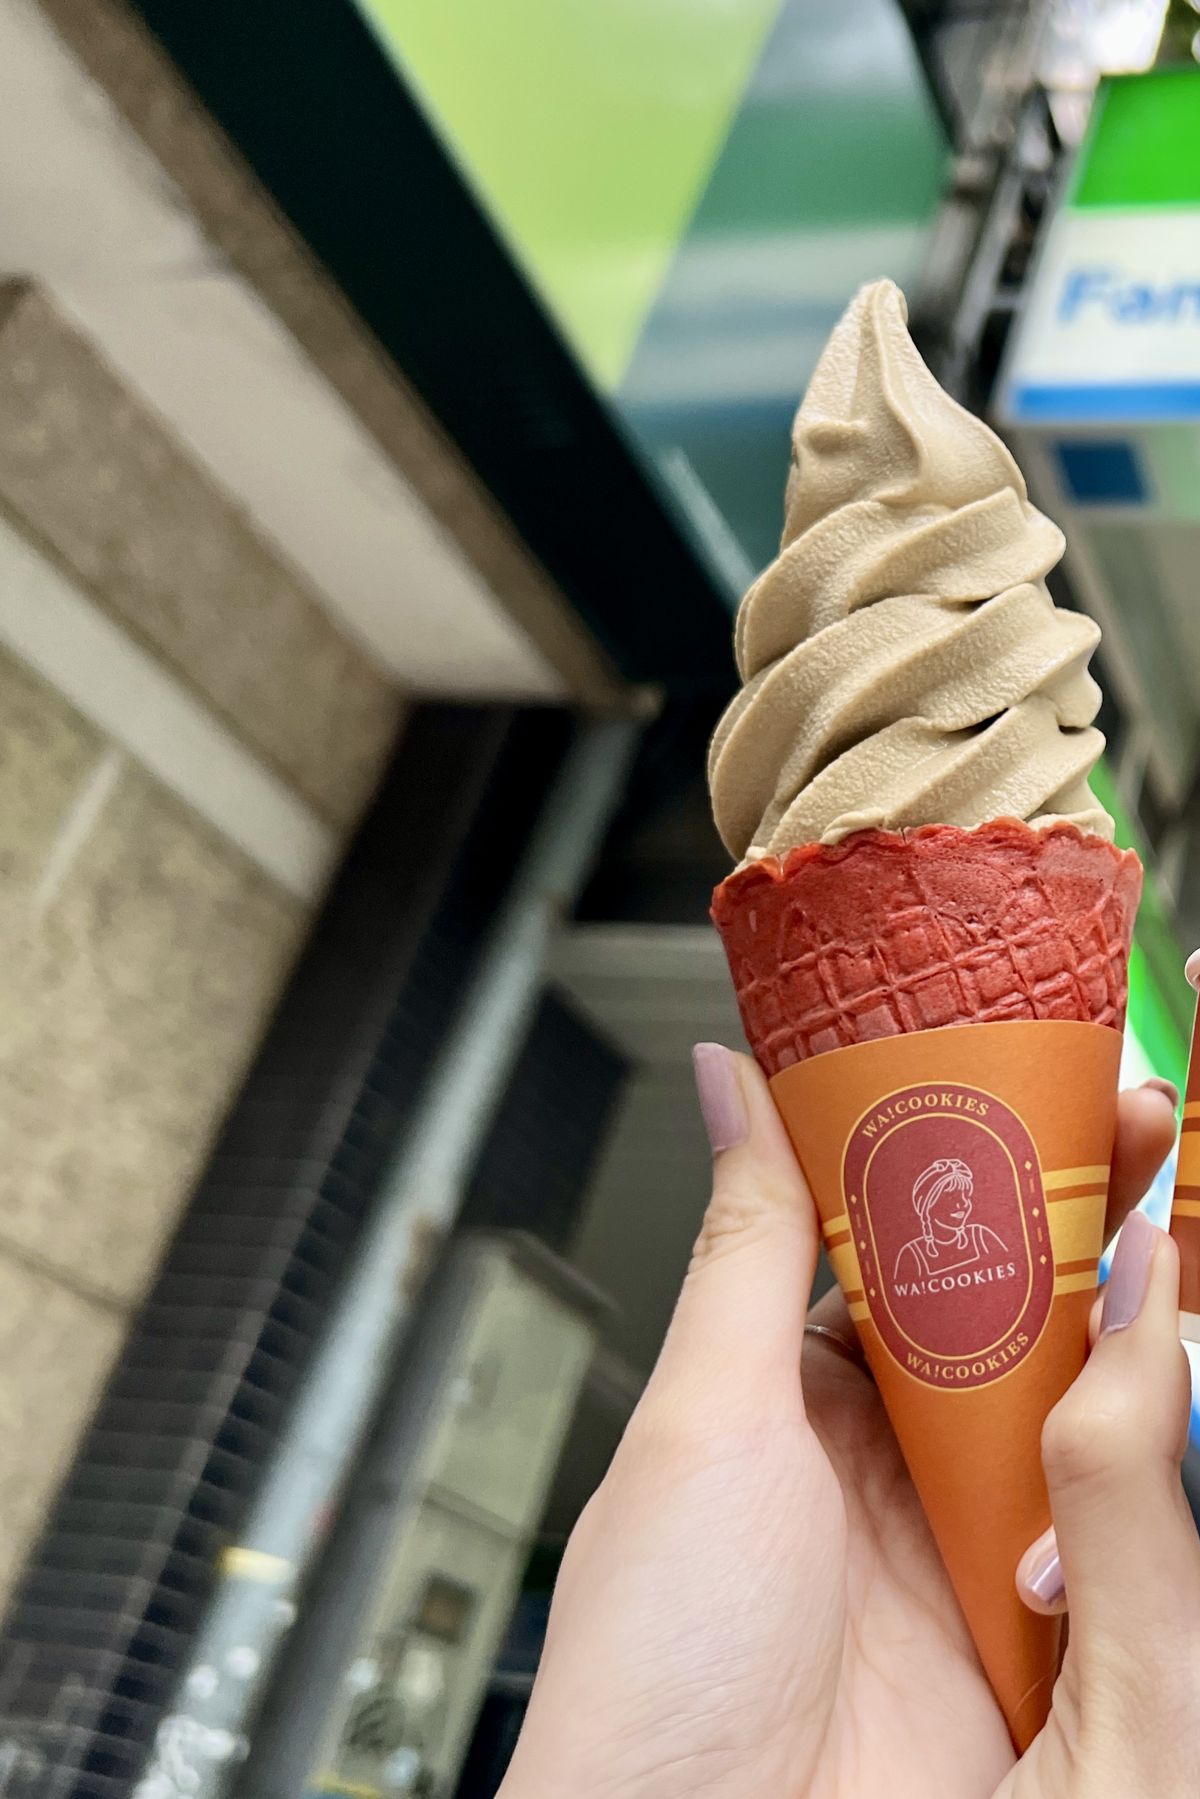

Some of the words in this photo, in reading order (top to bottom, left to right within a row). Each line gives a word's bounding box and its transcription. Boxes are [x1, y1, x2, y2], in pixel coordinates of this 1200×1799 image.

[862, 1092, 989, 1139] WA!COOKIES
[894, 1262, 1016, 1297] WA!COOKIES
[906, 1332, 1030, 1380] WA!COOKIES
